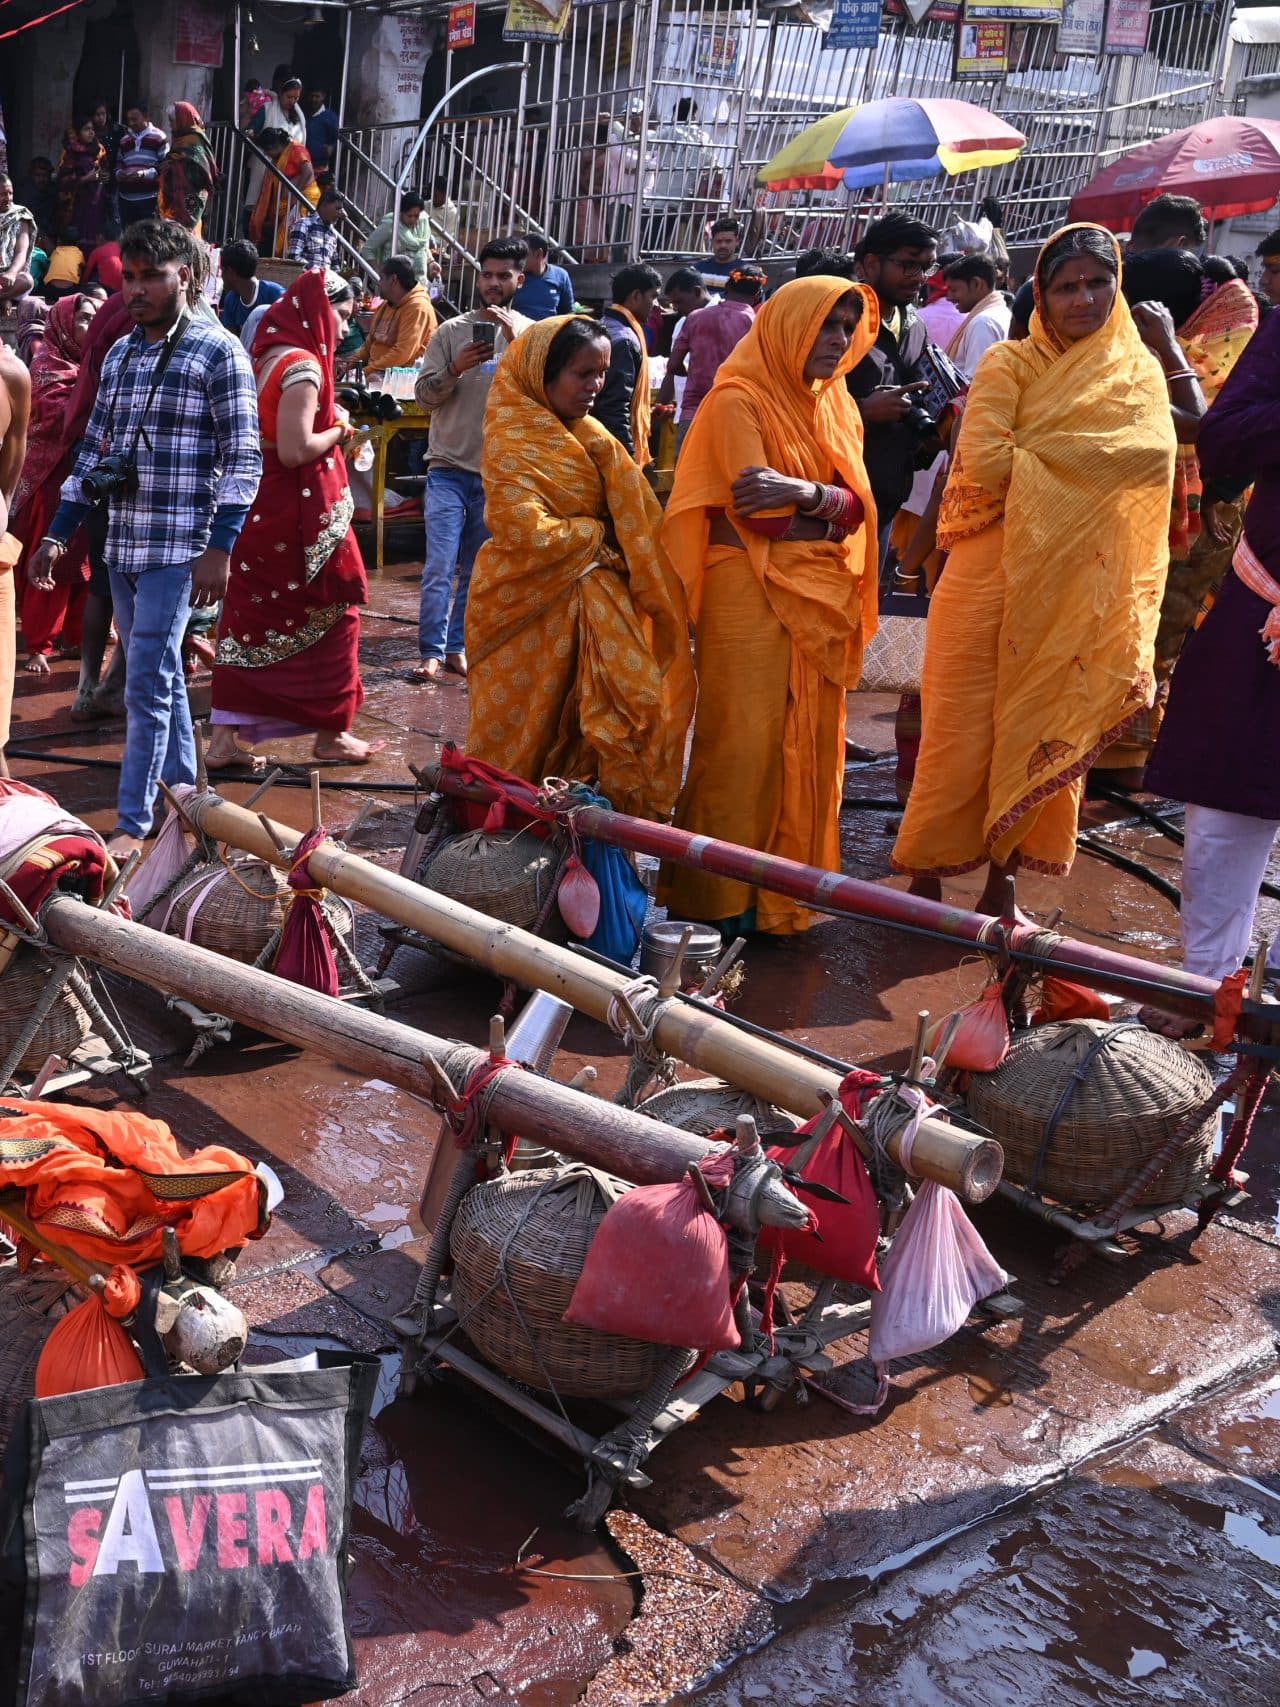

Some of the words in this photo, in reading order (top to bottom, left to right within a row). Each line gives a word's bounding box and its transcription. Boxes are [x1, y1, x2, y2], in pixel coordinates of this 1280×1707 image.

[66, 1468, 328, 1588] SAVERA
[81, 1653, 102, 1666] 1ST
[144, 1641, 184, 1656] SURAJ
[158, 1655, 214, 1673] GUWAHATI
